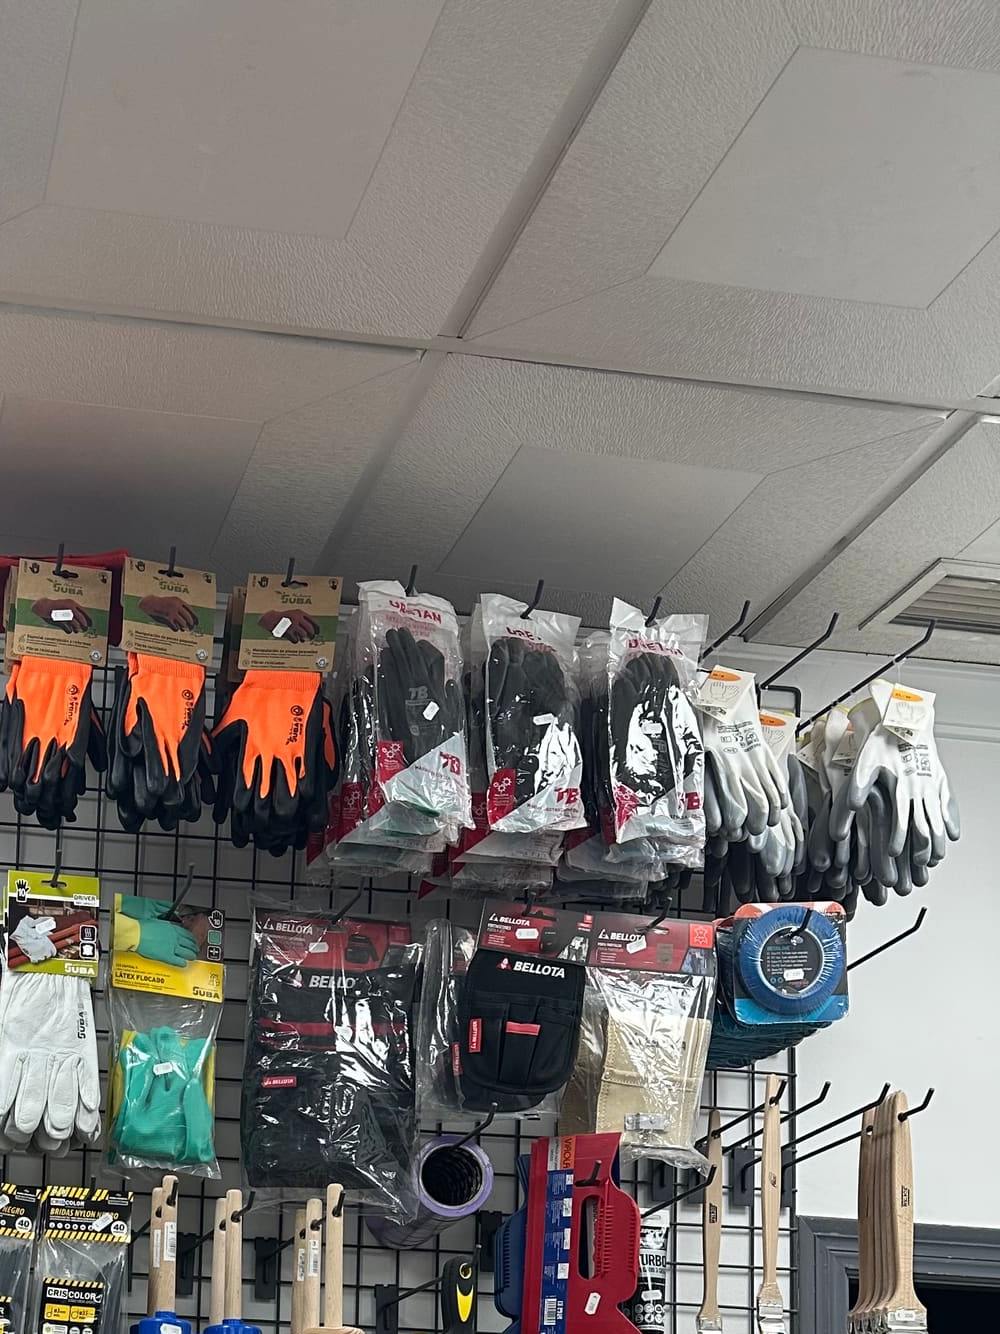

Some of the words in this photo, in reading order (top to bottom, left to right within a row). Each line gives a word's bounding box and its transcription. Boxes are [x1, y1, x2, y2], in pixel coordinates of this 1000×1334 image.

[499, 916, 530, 926] BELLOTA
[276, 922, 313, 935] BELLOTA
[65, 963, 95, 975] JUBA
[115, 971, 135, 980] LÁTEX
[513, 962, 565, 978] BELLOTA
[193, 987, 220, 1000] JUBA
[77, 1012, 87, 1039] JUBA
[50, 1208, 74, 1216] BRIDAS
[75, 1209, 95, 1218] NYLON
[47, 1287, 96, 1300] CRISCOLOR
